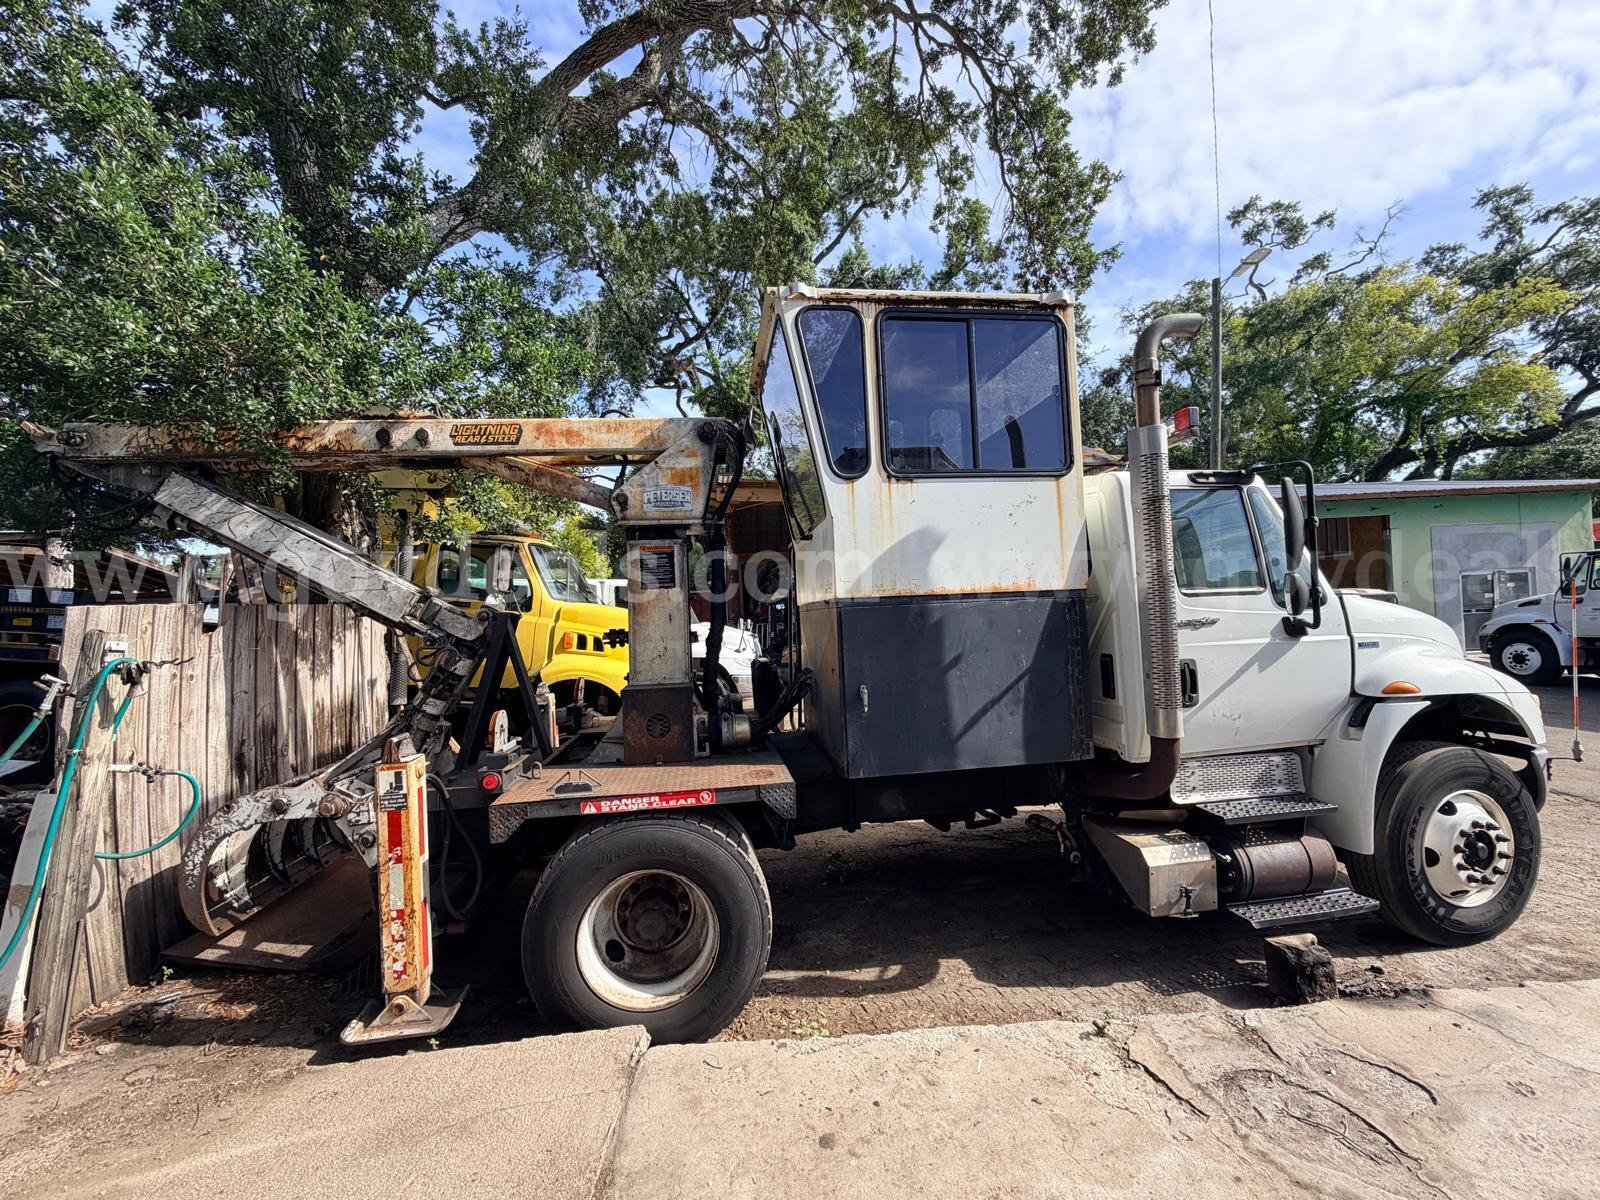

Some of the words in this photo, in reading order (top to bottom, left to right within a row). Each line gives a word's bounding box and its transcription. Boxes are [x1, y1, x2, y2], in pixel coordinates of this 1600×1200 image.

[450, 424, 520, 435] LIGHTNING
[454, 435, 480, 443] REAR
[487, 434, 517, 443] STEER
[600, 796, 660, 807] DANGER
[600, 802, 648, 812] STAND
[652, 797, 696, 808] CLEAR
